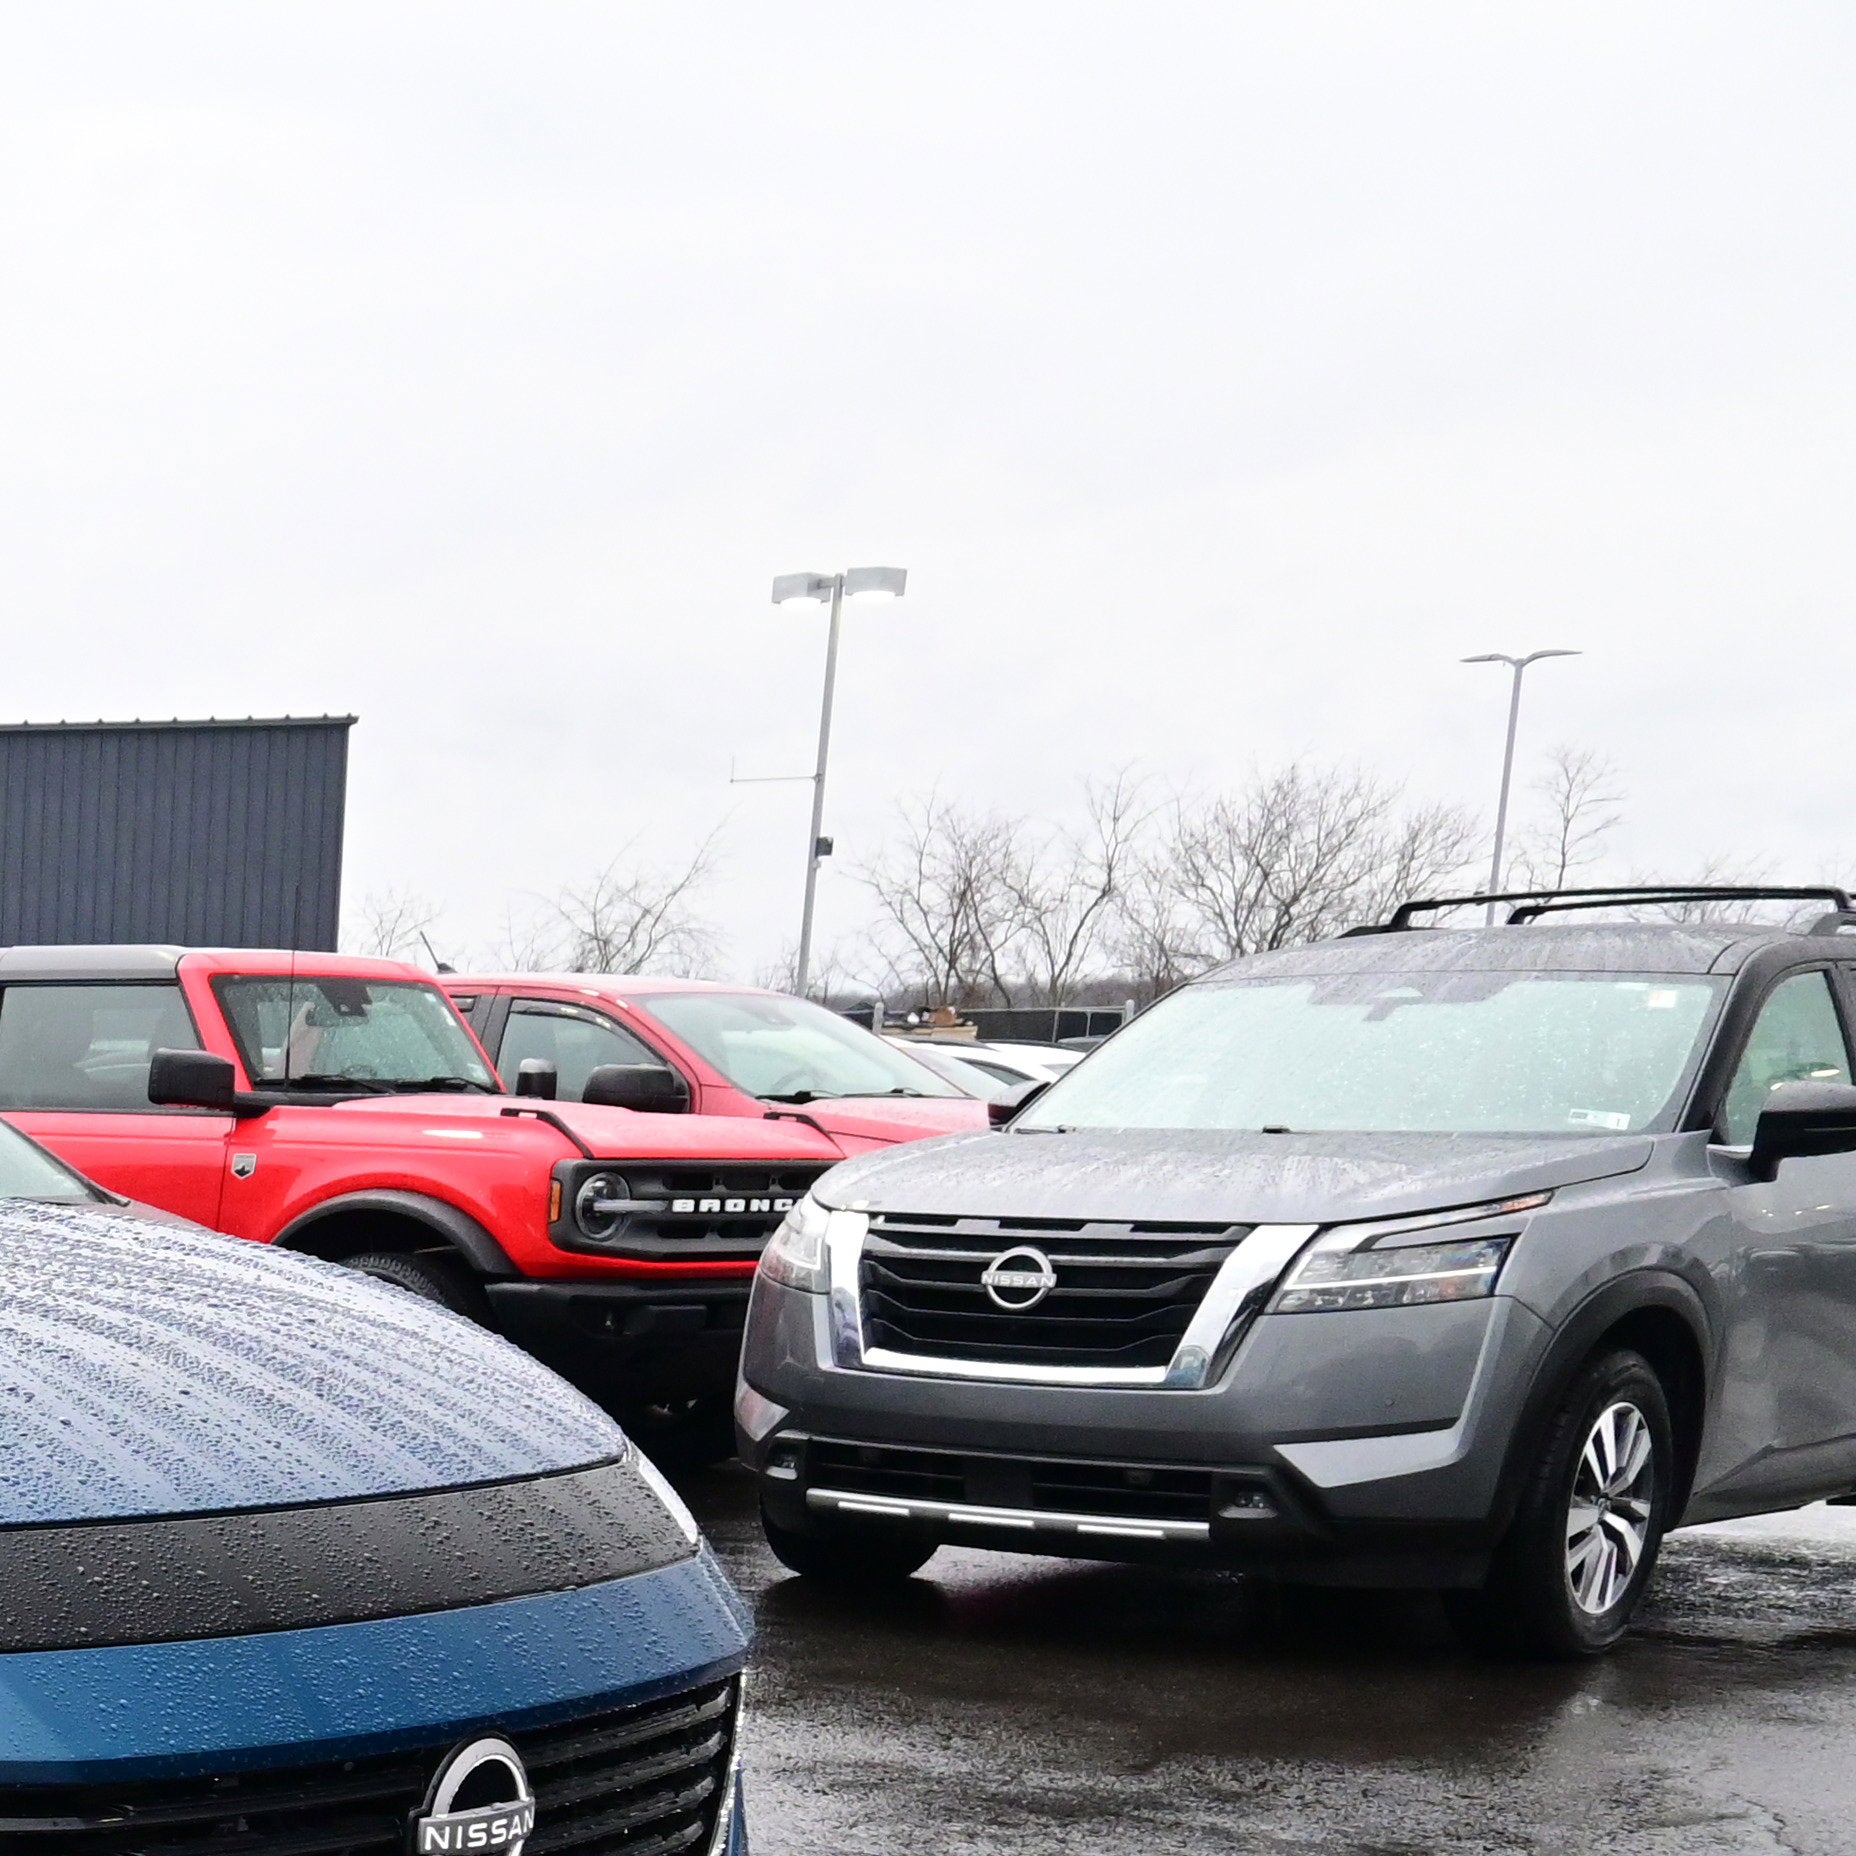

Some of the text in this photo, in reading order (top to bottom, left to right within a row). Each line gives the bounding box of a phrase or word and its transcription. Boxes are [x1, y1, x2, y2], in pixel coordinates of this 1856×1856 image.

[672, 1199, 799, 1212] BRONC
[982, 1273, 1054, 1287] NISSAN
[424, 1806, 535, 1851] NISSAN
